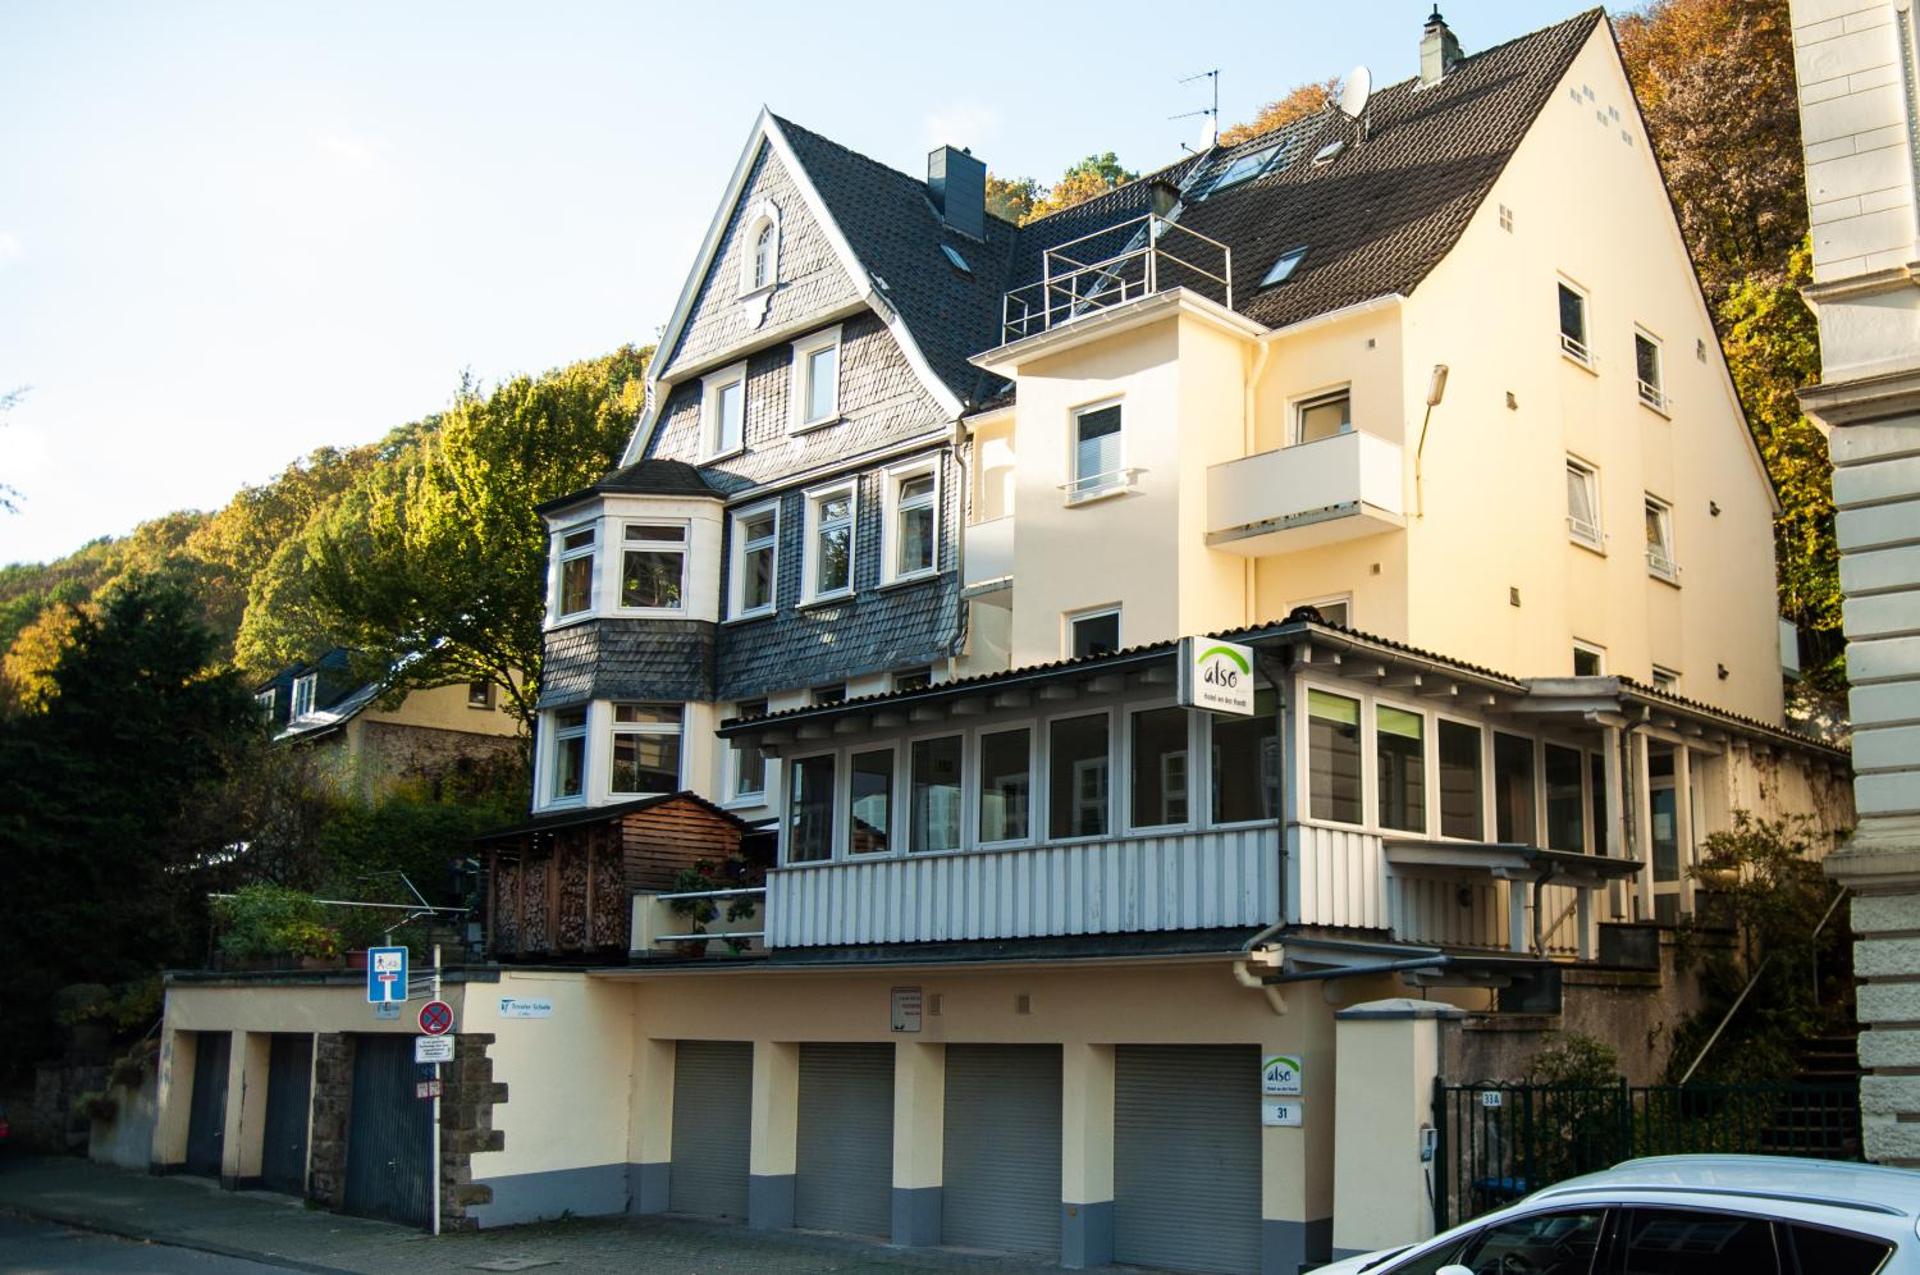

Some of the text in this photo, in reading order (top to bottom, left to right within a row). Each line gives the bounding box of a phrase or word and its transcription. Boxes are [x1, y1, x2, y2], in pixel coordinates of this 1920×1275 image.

[1204, 660, 1237, 688] also
[1267, 1066, 1291, 1081] also
[1277, 1107, 1288, 1119] 31
